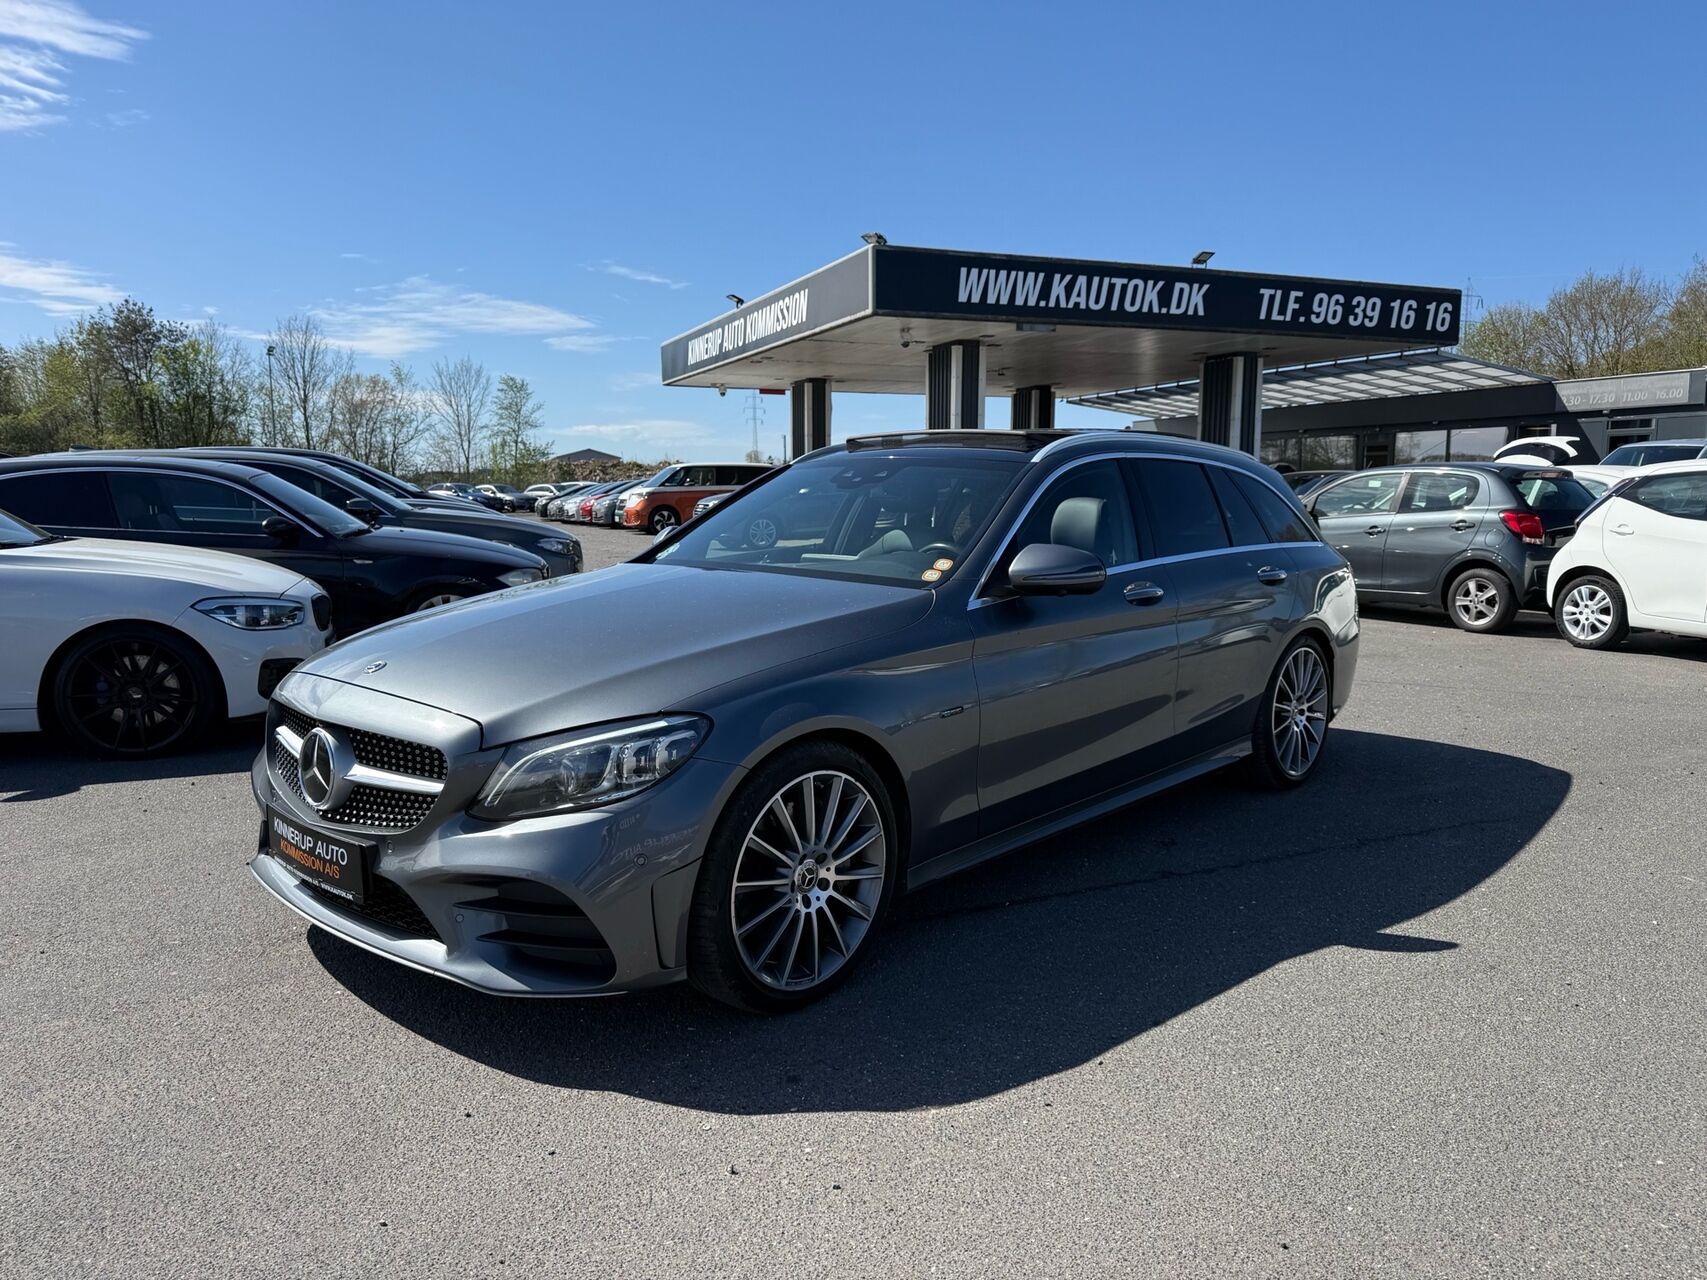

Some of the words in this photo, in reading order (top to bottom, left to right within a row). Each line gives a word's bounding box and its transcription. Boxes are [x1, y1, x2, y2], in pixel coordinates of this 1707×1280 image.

[957, 266, 1210, 316] WWW.KAUTOK.DK
[1259, 288, 1305, 322] TLF.
[1310, 292, 1345, 325] 96
[1348, 295, 1381, 328] 39
[1389, 298, 1418, 330] 16
[1425, 301, 1453, 332] 16
[687, 327, 723, 366] KINNERUP
[722, 317, 745, 353] AUTO
[745, 288, 809, 344] KOMMISSION
[1589, 393, 1616, 405] 17.30
[1655, 388, 1684, 400] 16.00
[273, 816, 314, 852] KINNERUP
[315, 840, 348, 866] AUTO
[280, 838, 323, 873] KOMMISSION
[324, 863, 340, 879] A/S
